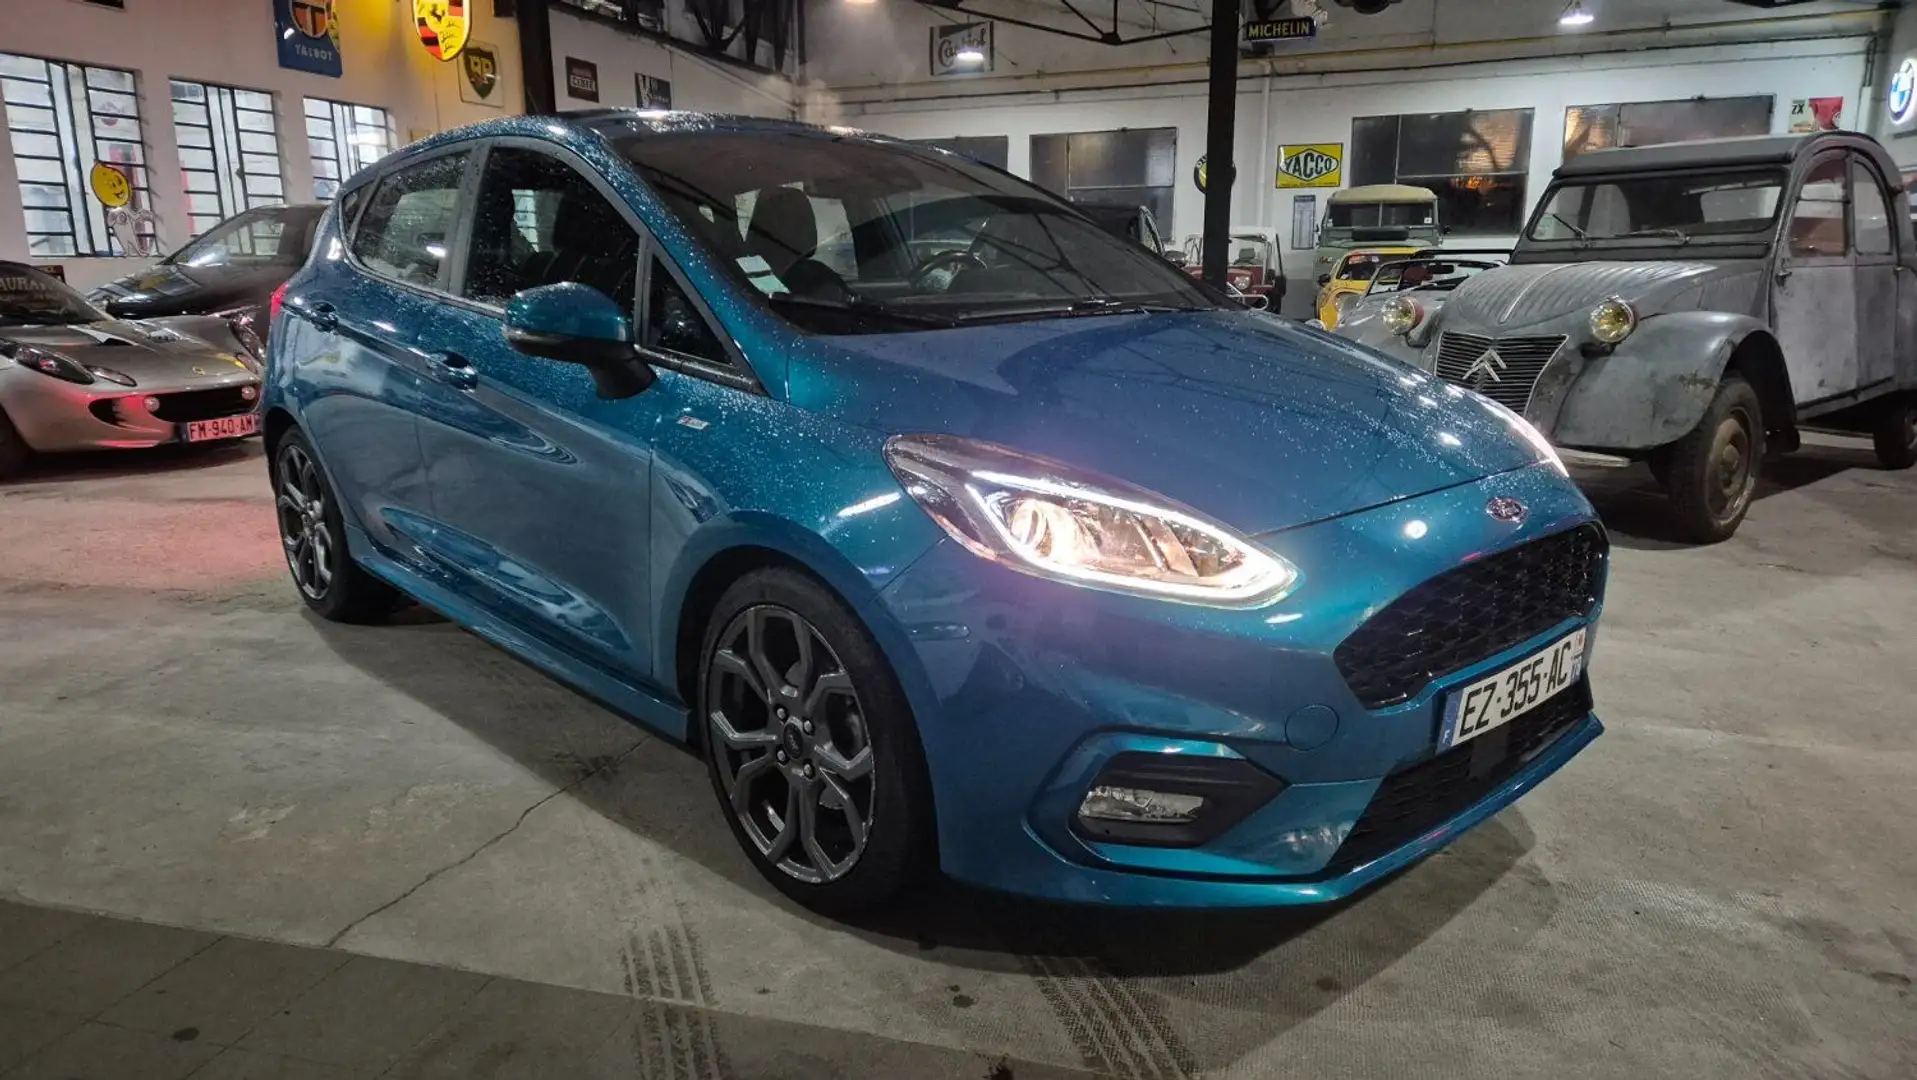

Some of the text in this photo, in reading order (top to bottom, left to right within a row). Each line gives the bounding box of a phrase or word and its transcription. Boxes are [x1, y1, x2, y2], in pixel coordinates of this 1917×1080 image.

[1248, 20, 1310, 37] MICHELIN
[294, 43, 333, 61] TALBOT
[1791, 103, 1805, 115] ZX
[1284, 152, 1333, 179] YACCO
[1459, 641, 1571, 737] EZ-355-AC
